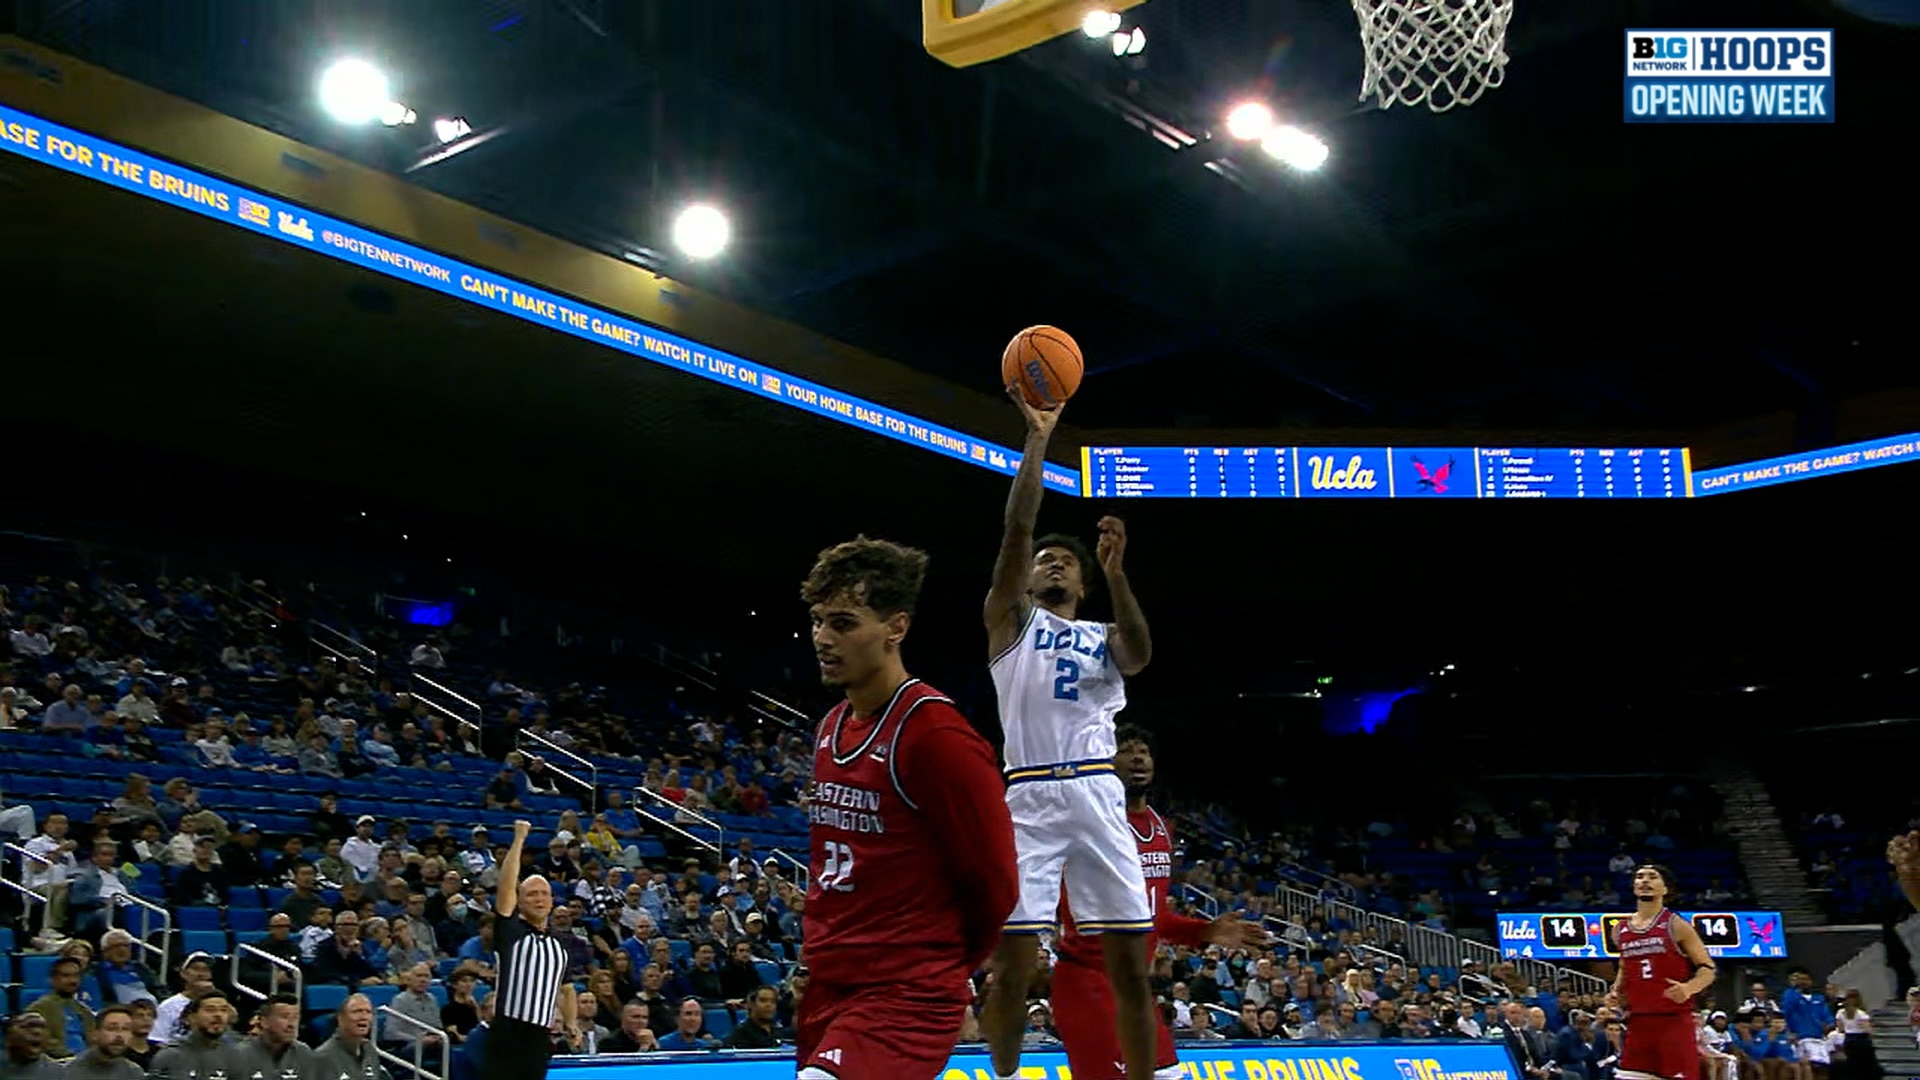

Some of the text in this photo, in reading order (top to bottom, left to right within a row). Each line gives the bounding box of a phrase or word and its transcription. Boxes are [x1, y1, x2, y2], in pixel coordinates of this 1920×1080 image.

[0, 119, 40, 150] ASE
[46, 135, 93, 168] FOR
[97, 151, 144, 184] THE
[149, 169, 230, 212] BRUINS
[321, 229, 451, 283] @BIGTENNETWORK
[461, 275, 509, 303] CAN'T
[512, 291, 556, 320] MAKE
[558, 306, 589, 330] THE
[592, 318, 640, 346] GAME?
[643, 335, 690, 364] WATCH
[693, 351, 706, 368] IT
[708, 356, 736, 379] LIVE
[738, 367, 757, 386] ON
[785, 382, 817, 405] YOUR
[820, 394, 853, 417] HOME
[855, 406, 884, 427] BASE
[886, 416, 906, 434] FOR
[907, 423, 928, 441] THE
[930, 431, 967, 454] BRUINS
[1308, 455, 1378, 490] Ucla
[1701, 472, 1741, 490] CAN'T
[1743, 465, 1781, 482] MAKE
[1782, 461, 1810, 474] THE
[1812, 451, 1861, 470] GAME?
[1863, 443, 1914, 461] WATCH
[1034, 628, 1108, 669] UCLA
[1053, 656, 1080, 702] 2
[1550, 918, 1576, 938] 14
[1701, 917, 1729, 936] 14
[1640, 958, 1653, 979] 2
